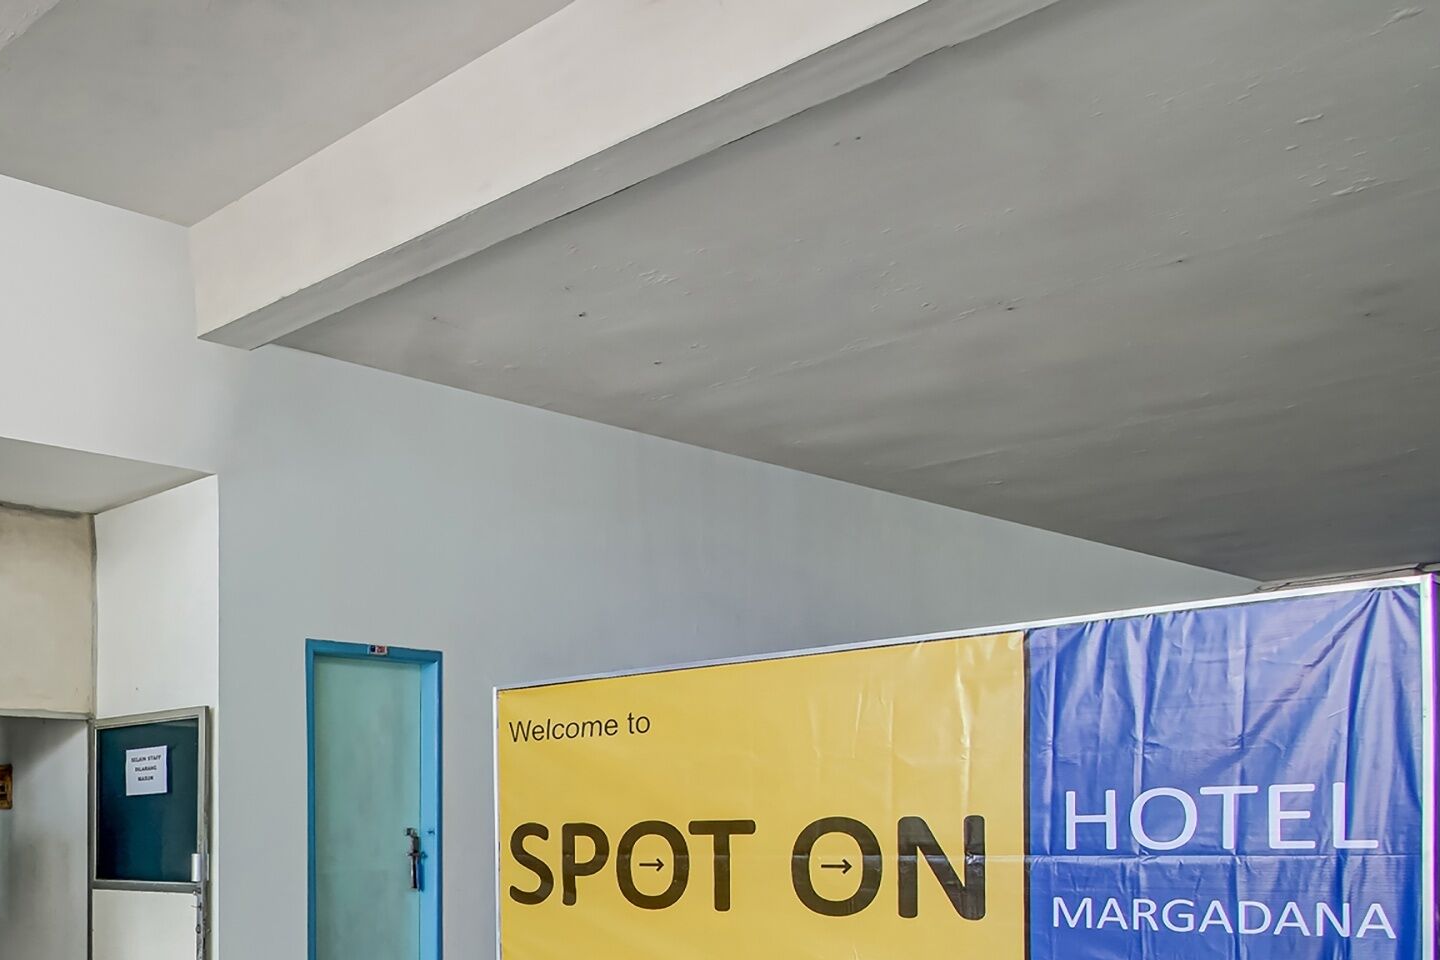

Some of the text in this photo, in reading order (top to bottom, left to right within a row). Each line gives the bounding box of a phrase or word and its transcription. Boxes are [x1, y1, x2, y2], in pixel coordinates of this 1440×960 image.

[509, 712, 651, 744] Welcome to
[1064, 782, 1379, 851] HOTEL
[508, 814, 987, 921] SPOT ON
[1052, 896, 1397, 941] MARGADANA
